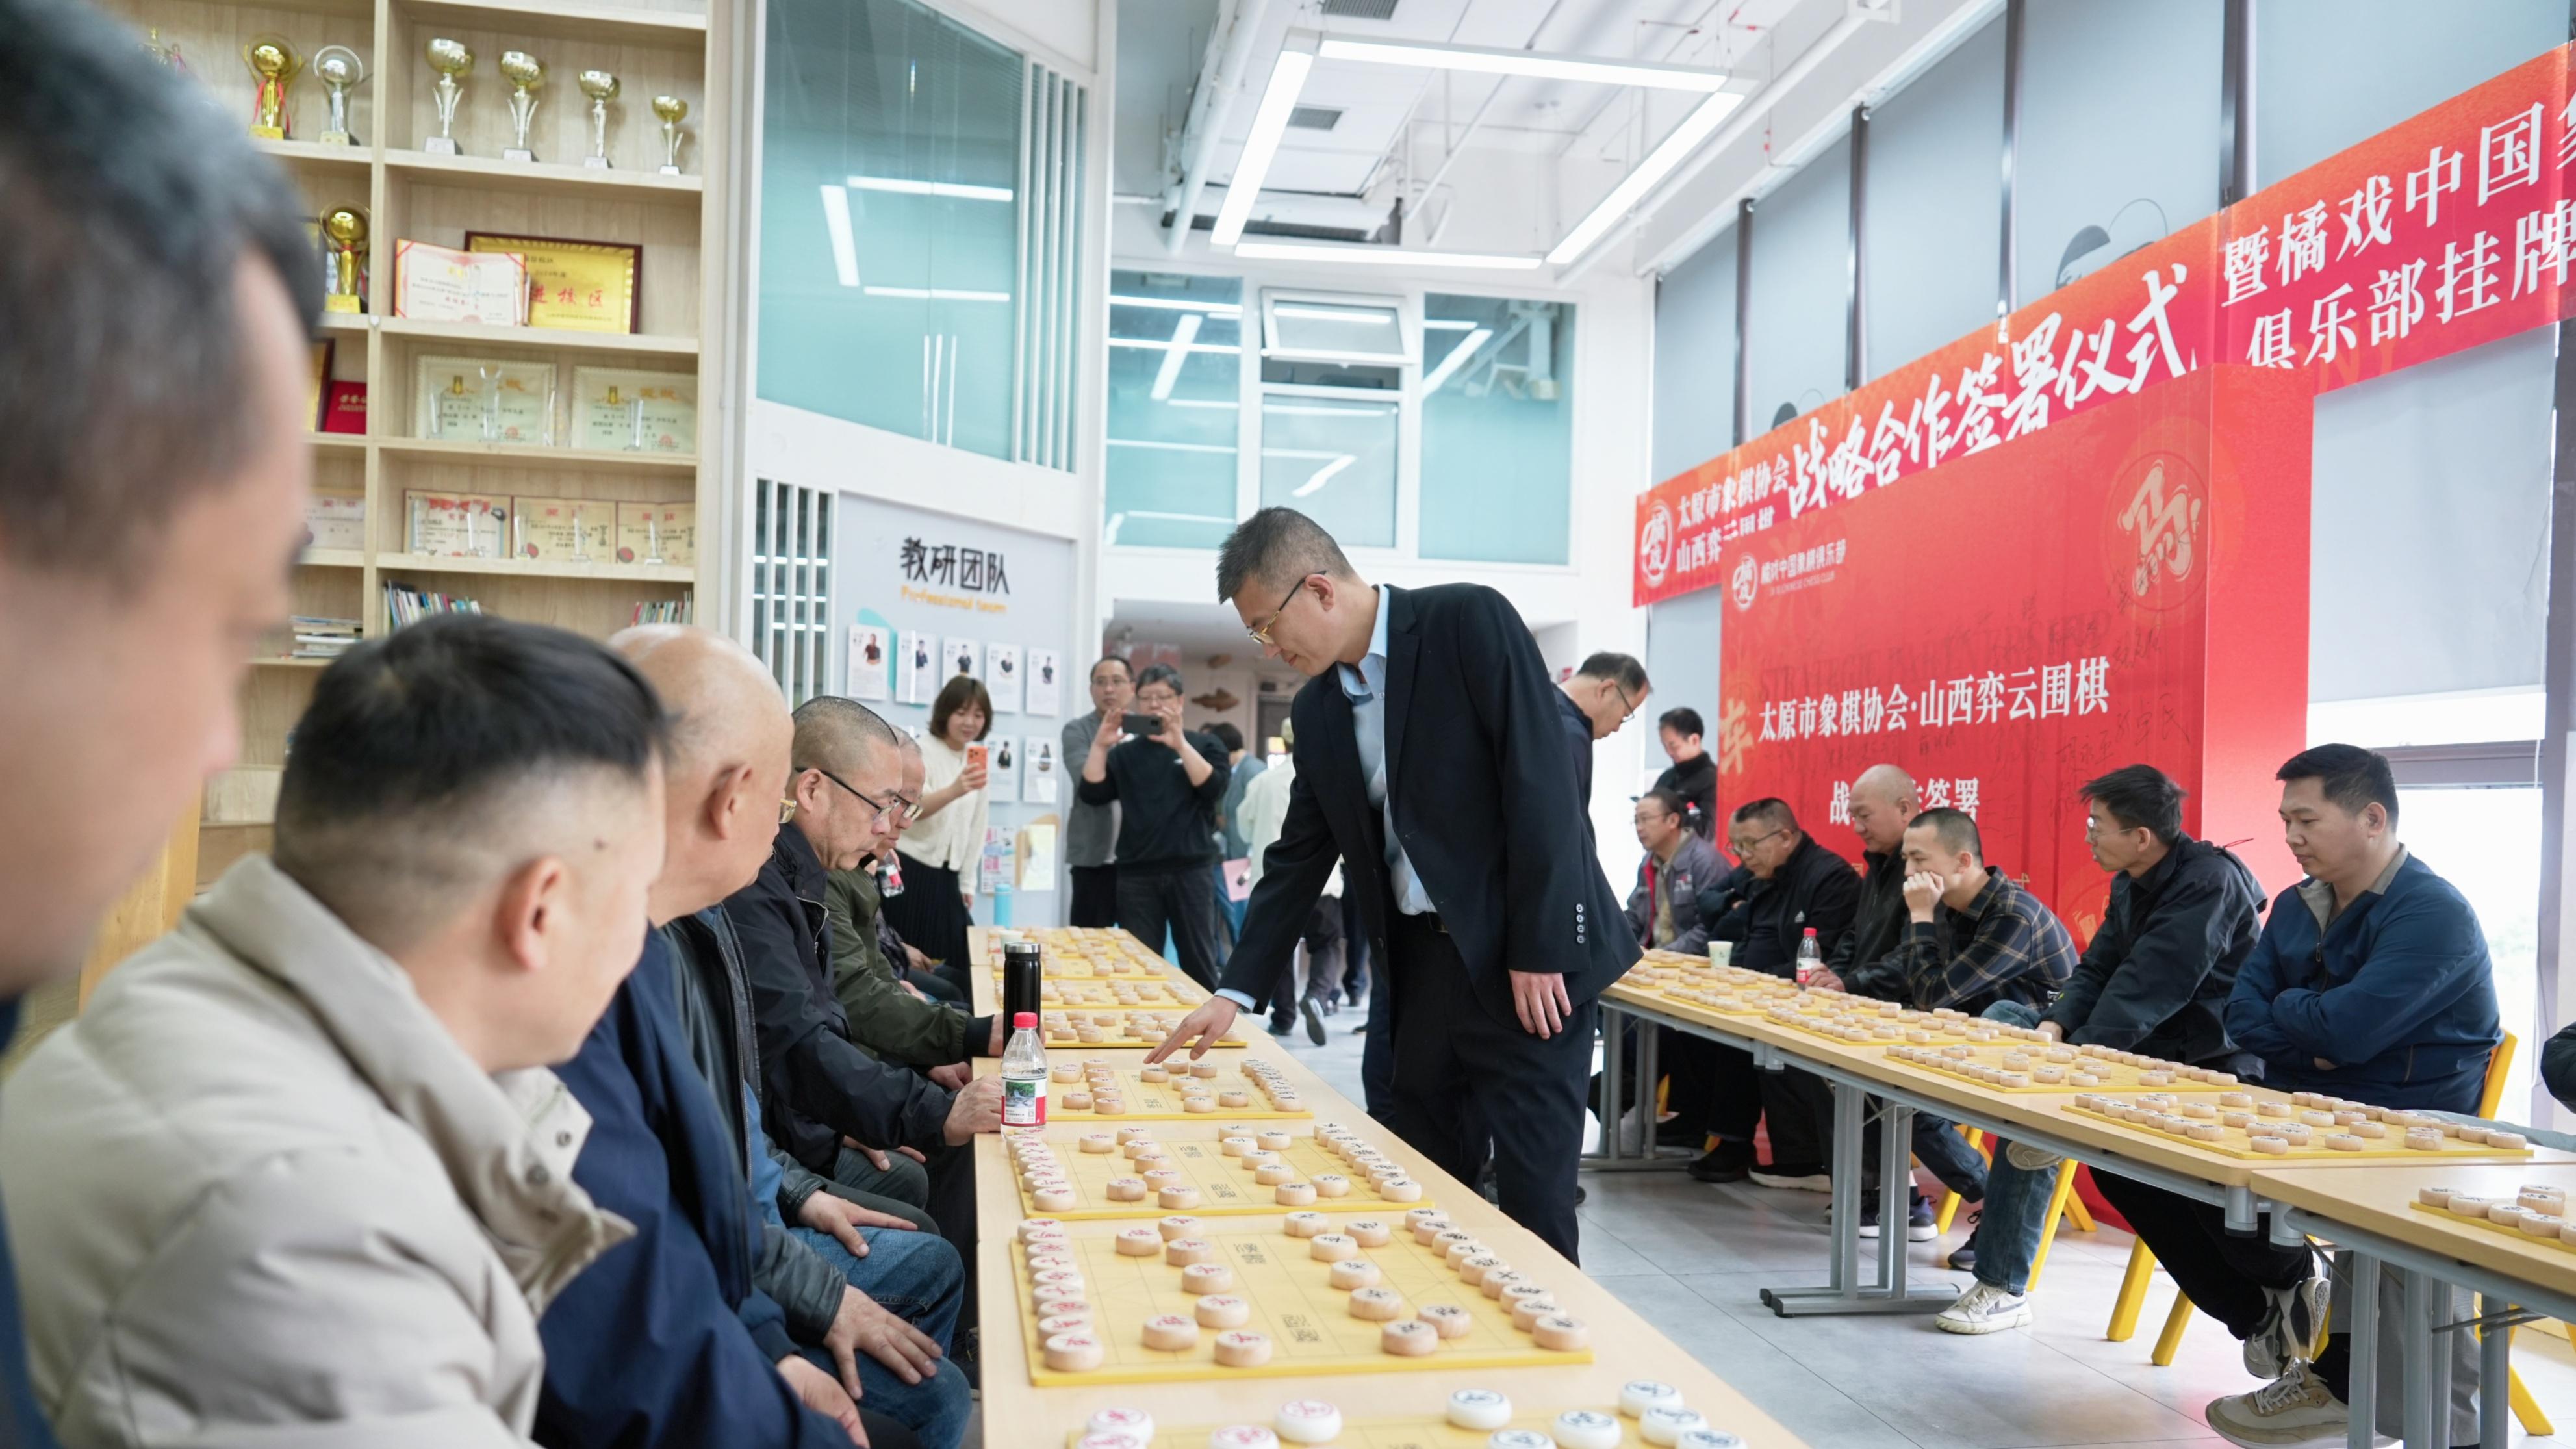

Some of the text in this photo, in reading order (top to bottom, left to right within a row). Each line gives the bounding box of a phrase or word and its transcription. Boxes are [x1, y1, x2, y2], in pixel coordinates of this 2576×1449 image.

[1787, 262, 2195, 519] 战略合作签署仪式
[1677, 453, 1789, 532] 太原市象棋协会
[900, 536, 1010, 595] 教研团队
[900, 584, 1008, 613] Professional team
[1758, 656, 2110, 743] 太原市象棋协会·山西弈云围棋
